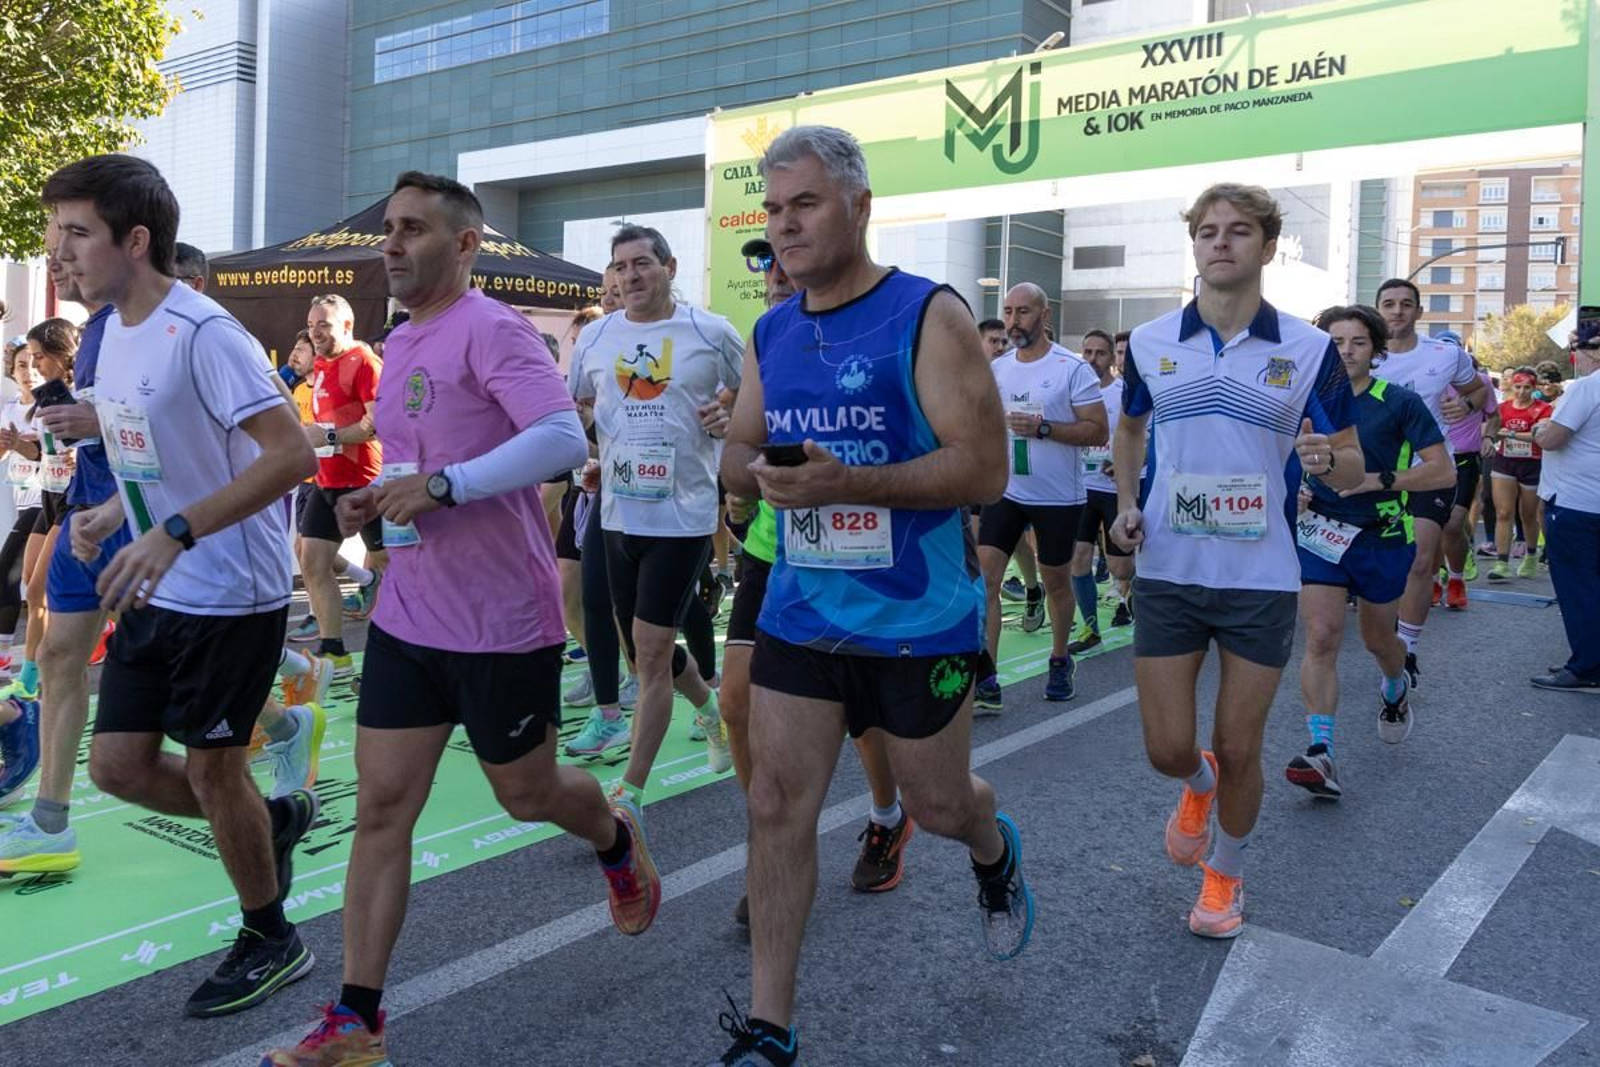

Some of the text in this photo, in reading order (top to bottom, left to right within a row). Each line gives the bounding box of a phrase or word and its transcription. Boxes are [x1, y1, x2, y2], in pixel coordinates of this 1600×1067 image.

[1141, 32, 1224, 68] XXVIII
[1057, 51, 1347, 116] MEDIA MARATÓN DE JAÉN
[1151, 91, 1314, 121] EN MEMORIA DE PACO MANZANEDA
[1083, 116, 1101, 136] &
[723, 165, 753, 181] CAJA
[744, 180, 766, 196] JAE
[719, 209, 768, 229] calde
[216, 264, 355, 288] www.evedeport.es
[469, 274, 603, 299] w.evedeport.es
[739, 290, 752, 301] de
[795, 406, 848, 432] VILLA
[849, 406, 886, 431] DE
[119, 428, 146, 449] 936
[637, 463, 667, 477] 840
[1210, 495, 1264, 511] 1104
[831, 511, 878, 531] 828
[1320, 528, 1352, 547] 1024
[0, 971, 79, 1005] TEA
